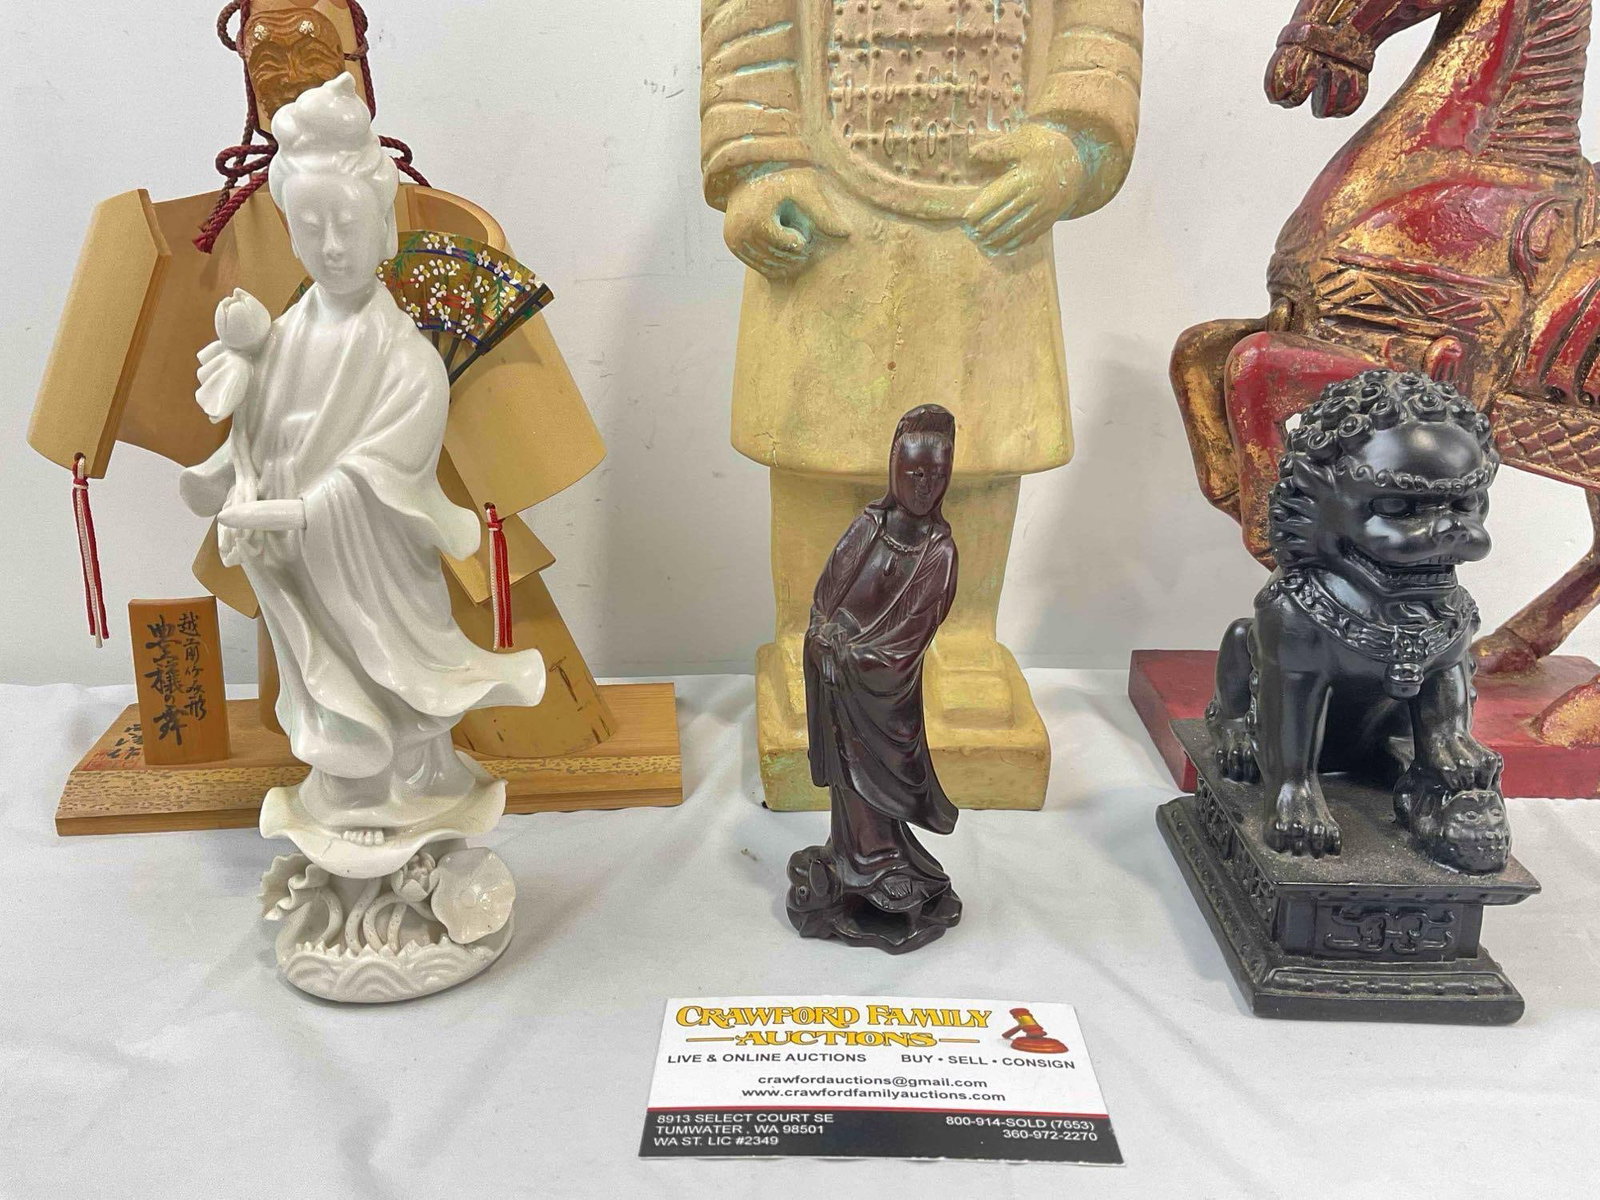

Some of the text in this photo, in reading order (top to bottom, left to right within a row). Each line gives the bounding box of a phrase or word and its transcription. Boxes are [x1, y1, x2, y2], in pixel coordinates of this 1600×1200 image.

[676, 1005, 992, 1028] CRAWFORD FAMILY
[735, 1030, 938, 1047] AUCTIONS
[667, 1053, 867, 1064] LIVE & ONLINE AUCTIONS
[901, 1054, 1076, 1070] BUY SELL CONSIGN
[758, 1075, 988, 1088] crawfordauctions@gmail.com
[742, 1088, 1006, 1101] www.crawfordfamilyauctions.com
[657, 1113, 834, 1124] 8913 SELECT COURT SE
[945, 1116, 1095, 1131] 800-914-SOLD (7653)
[754, 1125, 779, 1134] WA
[782, 1124, 824, 1134] 98501
[1002, 1129, 1098, 1142] 360-972-2270
[653, 1137, 678, 1146] WA
[708, 1136, 731, 1146] LIC
[735, 1135, 779, 1145] #2349
